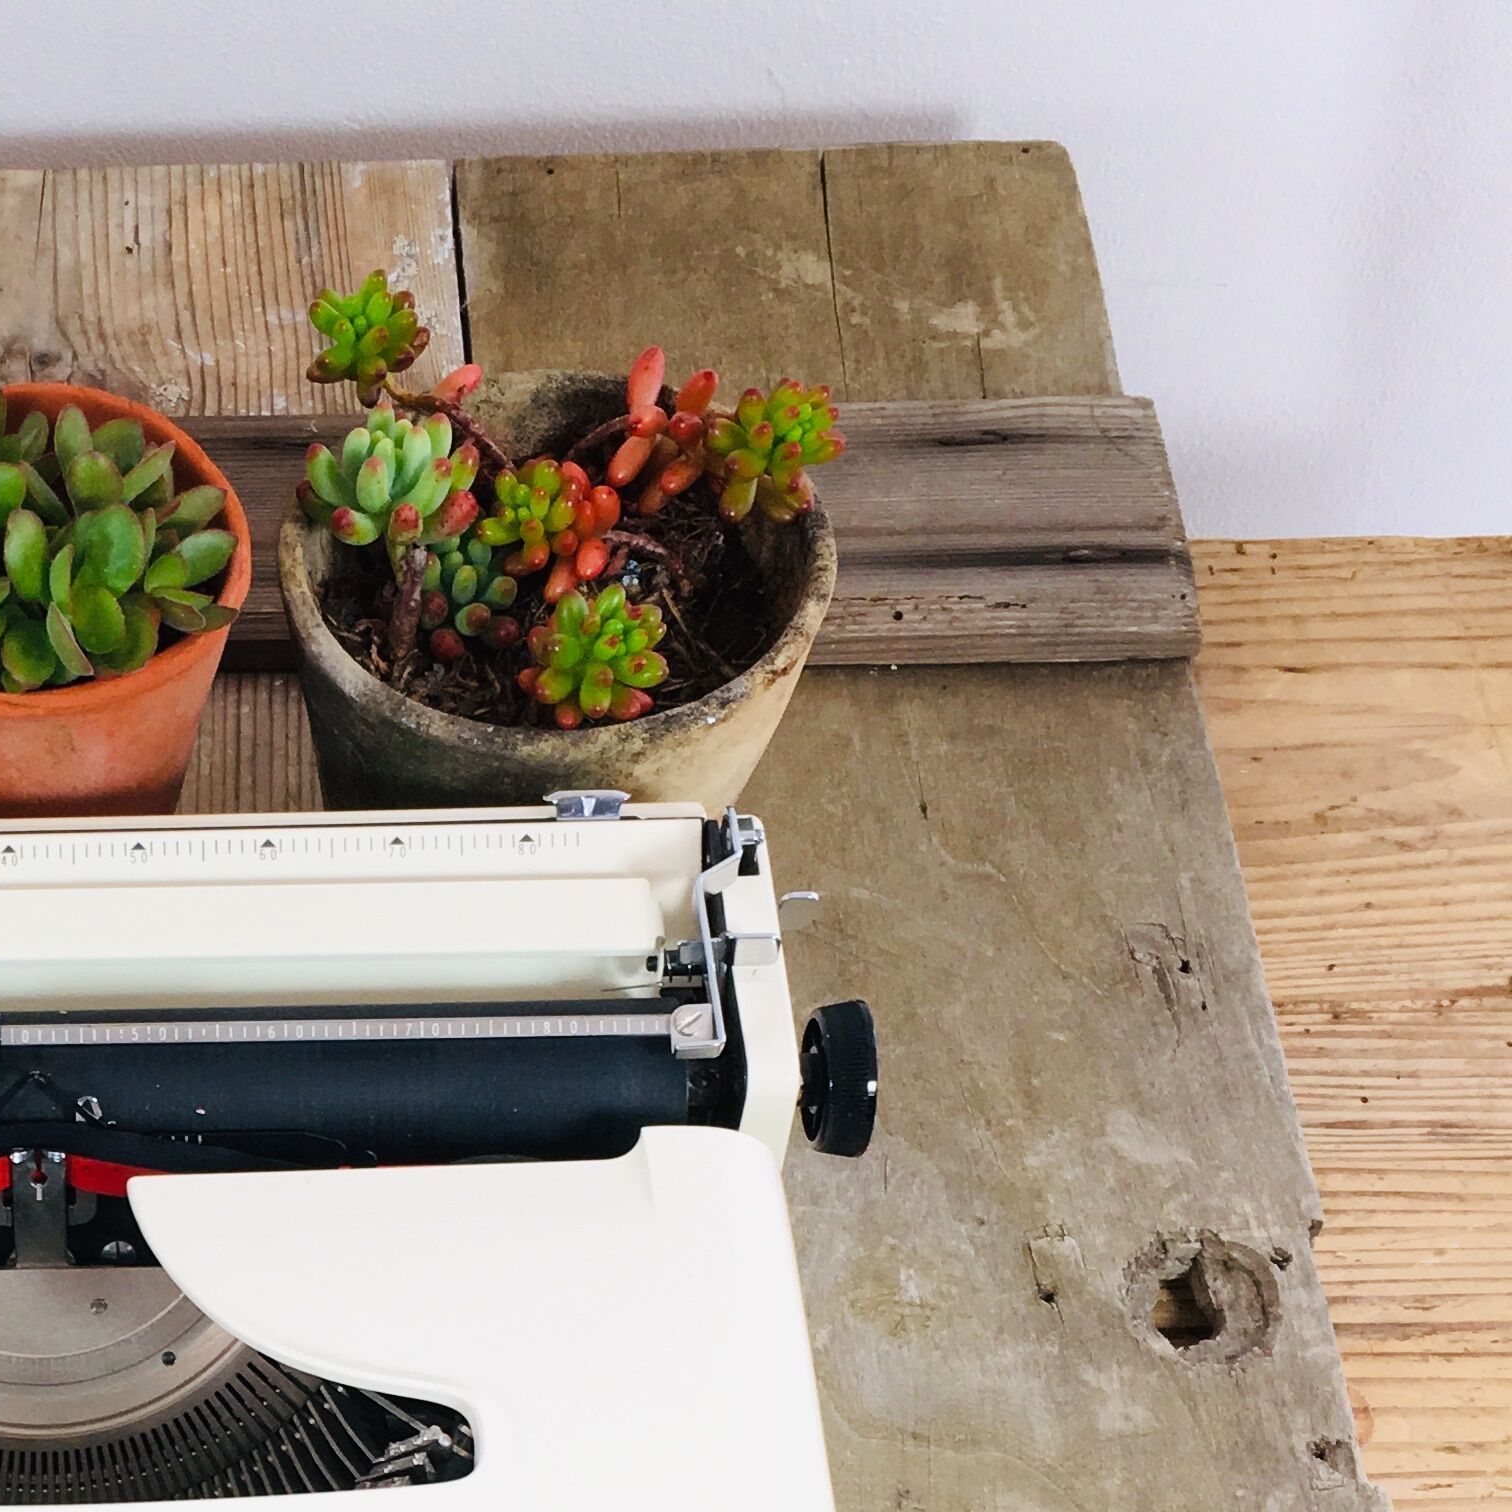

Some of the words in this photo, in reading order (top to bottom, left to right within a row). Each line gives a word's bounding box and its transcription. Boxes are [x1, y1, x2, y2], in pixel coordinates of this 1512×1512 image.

[0, 854, 19, 868] 40
[129, 851, 149, 865] 50
[258, 848, 278, 862] 60
[388, 846, 408, 859] 70
[517, 843, 537, 856] 80
